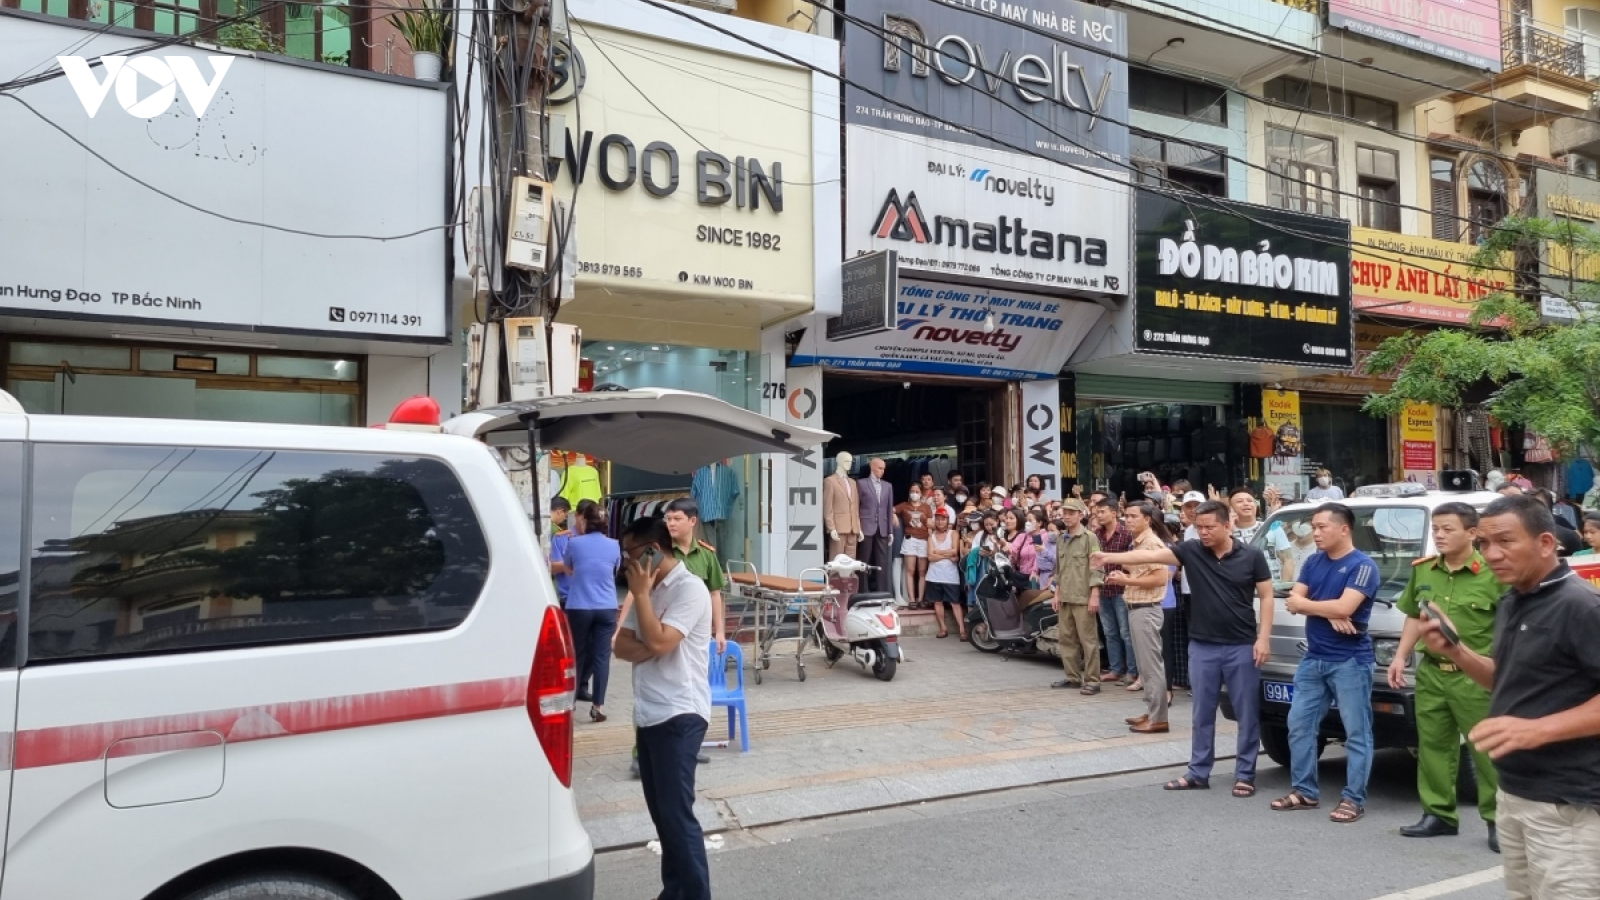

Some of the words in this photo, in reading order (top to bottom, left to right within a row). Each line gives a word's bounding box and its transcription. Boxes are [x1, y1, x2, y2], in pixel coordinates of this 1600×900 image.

[1001, 4, 1028, 22] MAY
[1032, 10, 1059, 31] NHÀ
[1061, 15, 1077, 34] BÈ
[883, 13, 1112, 131] novelty
[696, 150, 784, 213] BIN
[927, 161, 946, 175] ĐẠI
[984, 174, 1055, 206] novelty
[696, 224, 744, 247] SINCE
[746, 231, 782, 252] 1982
[934, 215, 1108, 267] mattana
[602, 263, 621, 276] 979
[623, 264, 643, 278] 565
[1158, 219, 1201, 278] ĐỒ
[1203, 244, 1240, 284] DA
[1240, 239, 1293, 290] BẢO
[1294, 257, 1340, 296] KIM
[693, 273, 712, 286] KIM
[713, 275, 736, 289] WOO
[738, 277, 753, 290] BIN
[1351, 260, 1392, 293] CHỤP
[1395, 258, 1429, 294] ẢNH
[1433, 264, 1460, 299] LẤY
[17, 284, 62, 303] Hưng
[65, 288, 101, 305] Đạo
[112, 292, 129, 304] TP
[132, 292, 163, 307] Bắc
[166, 296, 202, 310] Ninh
[900, 284, 934, 298] TỔNG
[935, 288, 971, 303] CÔNG
[1017, 299, 1043, 311] NHÀ
[1044, 302, 1061, 314] BÈ
[349, 310, 378, 323] 0971
[381, 313, 398, 325] 114
[401, 314, 422, 327] 391
[999, 312, 1064, 331] TRANG
[913, 324, 1023, 353] novelty
[763, 382, 786, 399] 276
[1269, 399, 1292, 409] Kodak
[1270, 409, 1297, 421] Express
[1407, 407, 1428, 416] Kodak
[1407, 417, 1433, 427] Express
